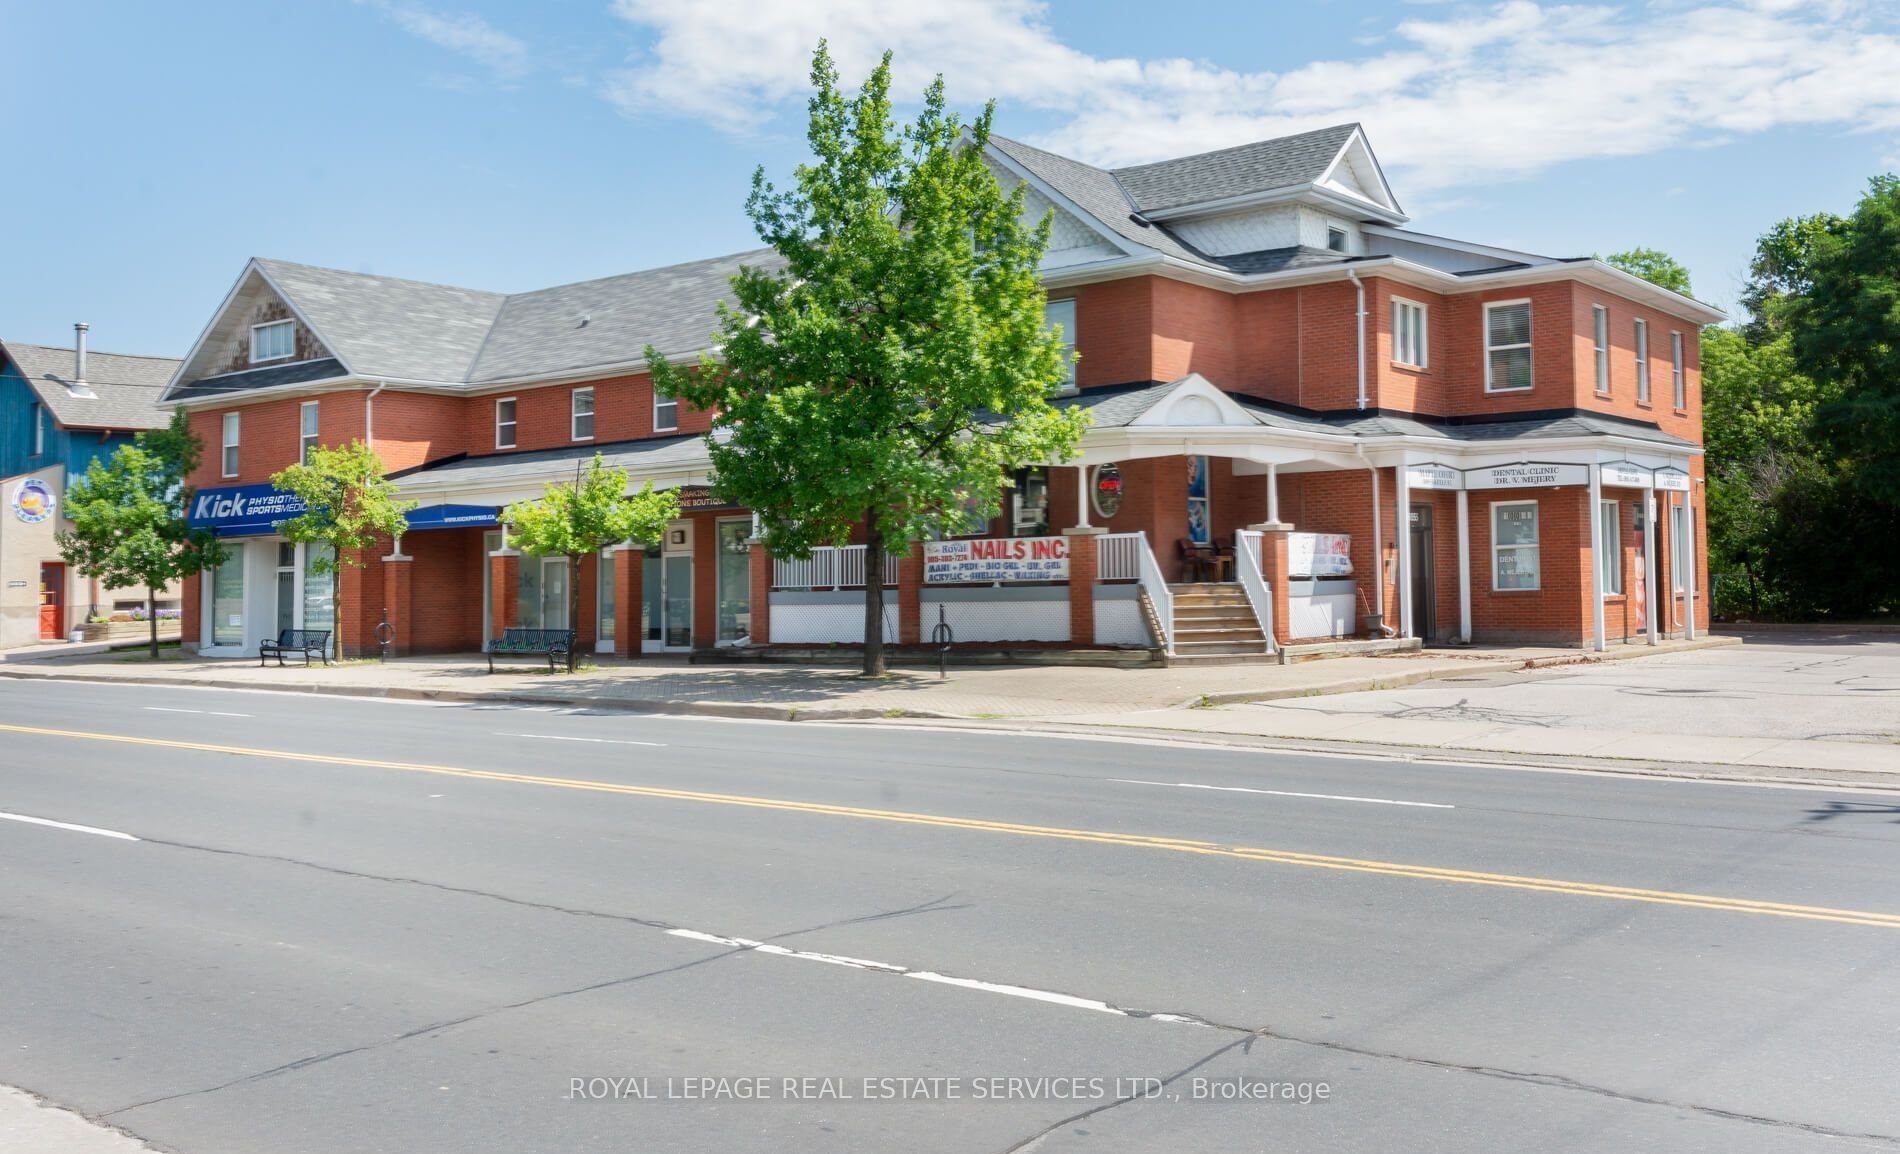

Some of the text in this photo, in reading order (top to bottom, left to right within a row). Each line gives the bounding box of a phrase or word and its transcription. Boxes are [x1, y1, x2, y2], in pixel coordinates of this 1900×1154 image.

[1492, 467, 1559, 477] DENTAL CLINIC
[1495, 477, 1510, 485] DR.
[194, 493, 246, 519] Kick
[970, 540, 1026, 560] NAILS
[1031, 539, 1071, 559] INC.
[928, 563, 950, 573] MANI
[959, 562, 978, 571] PEDI
[1003, 561, 1019, 570] GEL
[1043, 561, 1061, 569] GEL
[928, 572, 963, 582] ACRYLIC
[969, 571, 1007, 581] SHELLAC
[1014, 570, 1050, 580] WAXING
